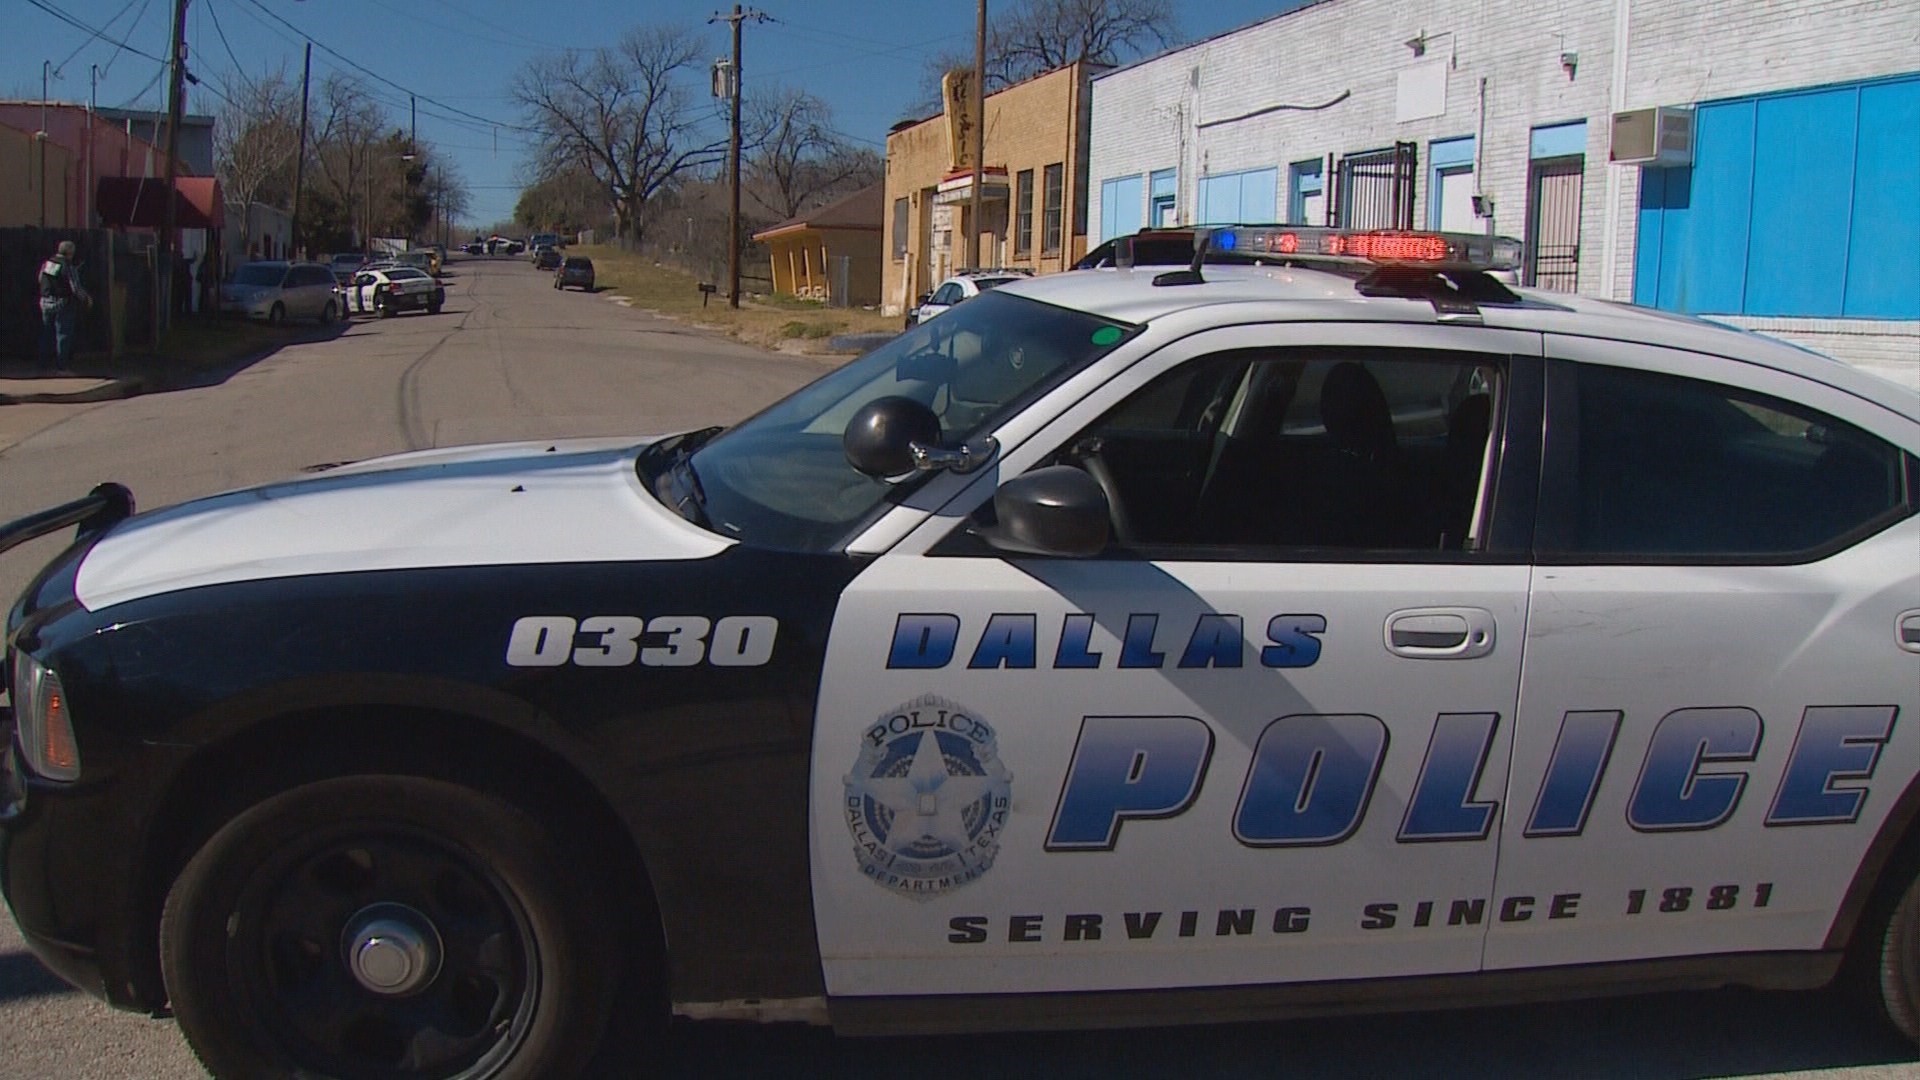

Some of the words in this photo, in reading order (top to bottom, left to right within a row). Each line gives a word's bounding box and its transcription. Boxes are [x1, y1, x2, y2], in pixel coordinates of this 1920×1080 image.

[506, 615, 779, 667] 0330
[886, 612, 1327, 670] DALLAS
[867, 710, 990, 747] POLICE
[1043, 704, 1900, 852] POLICE
[848, 796, 886, 862] DALLAS
[964, 796, 1008, 857] TEXAS
[864, 862, 988, 890] DEPARTMENT
[948, 906, 1312, 944] SERVING
[1360, 893, 1582, 931] SINCE
[1626, 883, 1774, 915] 1881
